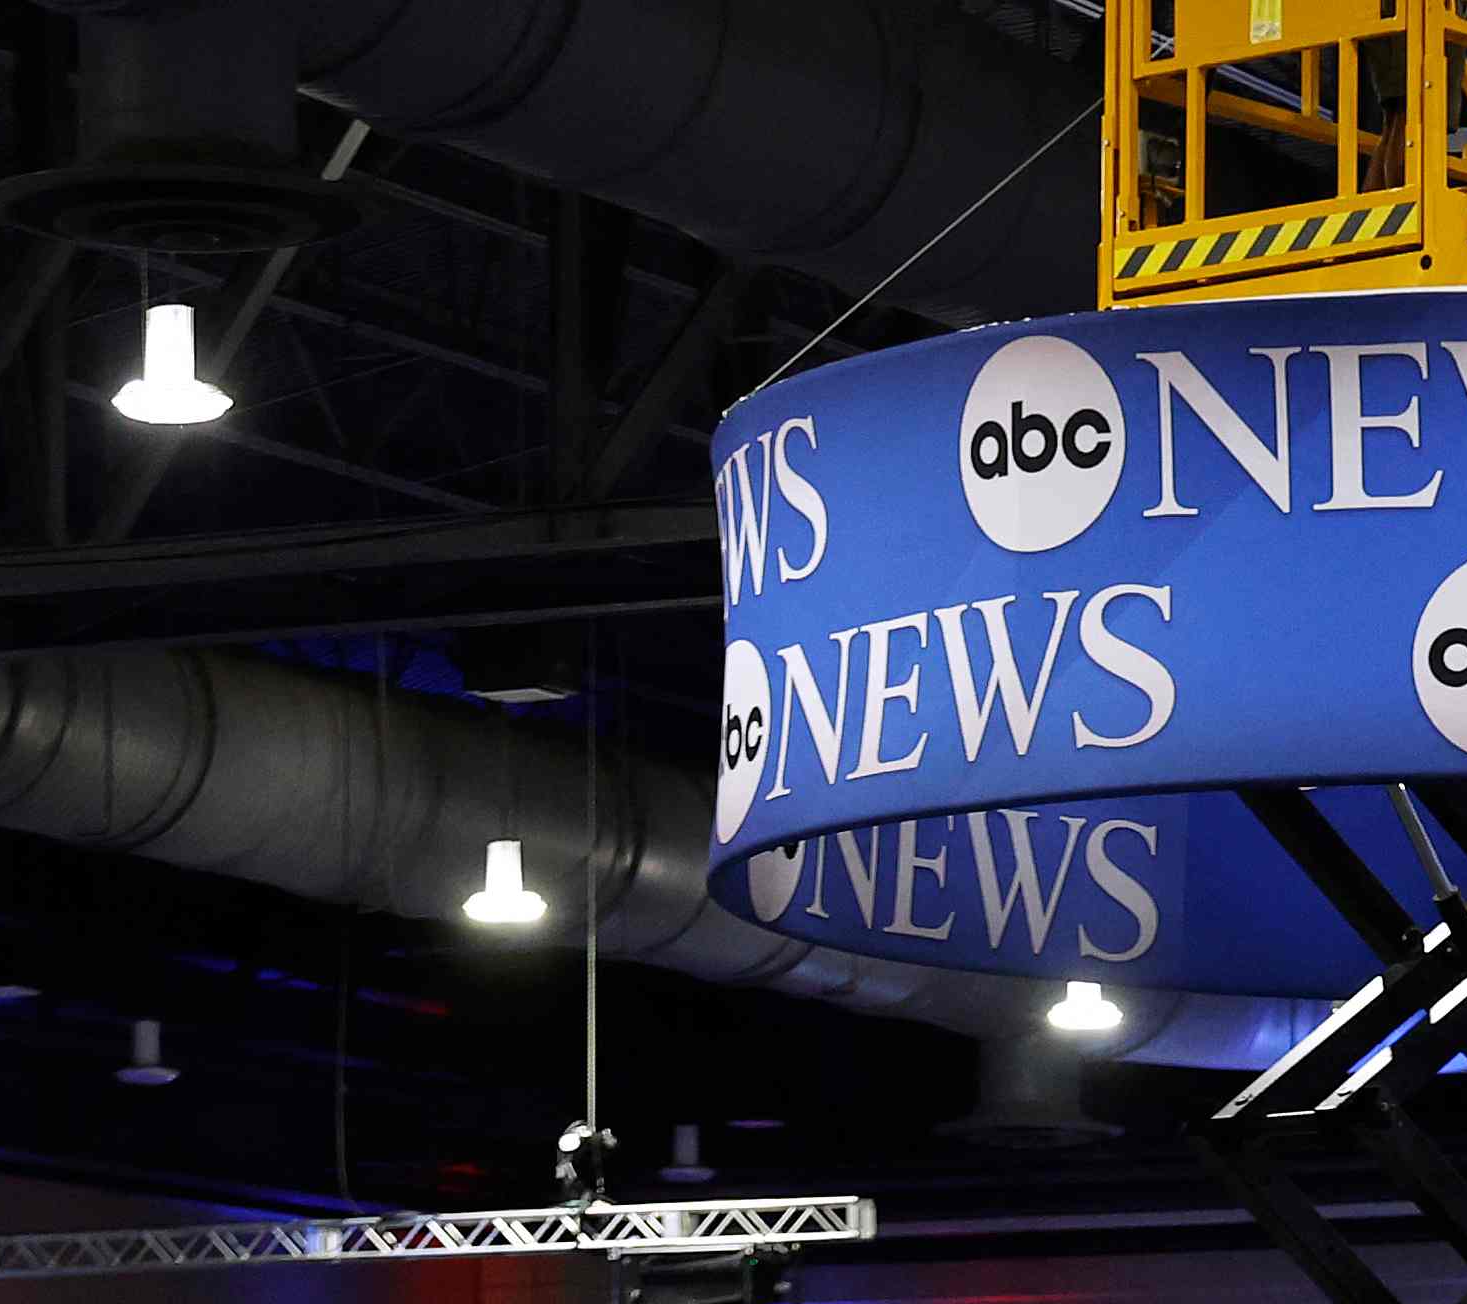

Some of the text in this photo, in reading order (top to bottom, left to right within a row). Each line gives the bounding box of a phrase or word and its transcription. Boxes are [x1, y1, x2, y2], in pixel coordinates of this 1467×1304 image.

[719, 414, 830, 606] WS
[971, 401, 1111, 480] abc
[720, 583, 1176, 801] bc NEWS
[806, 809, 1160, 964] NEWS
